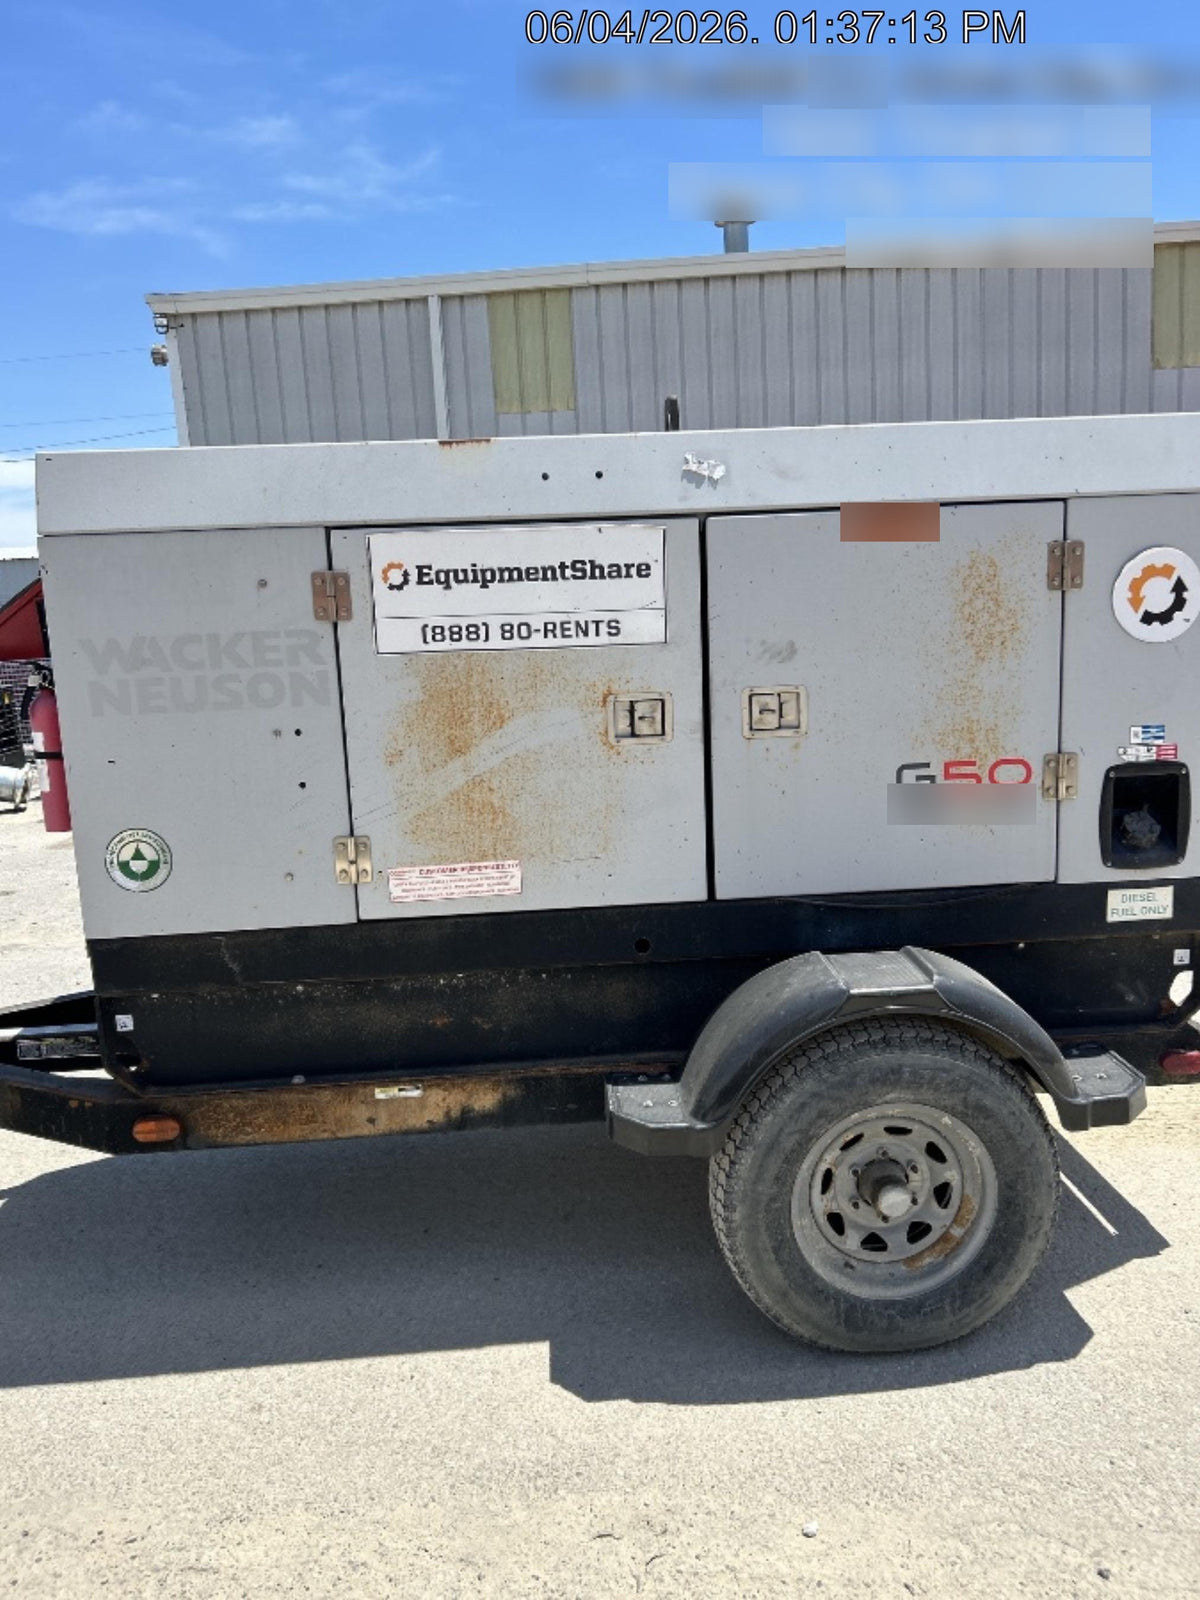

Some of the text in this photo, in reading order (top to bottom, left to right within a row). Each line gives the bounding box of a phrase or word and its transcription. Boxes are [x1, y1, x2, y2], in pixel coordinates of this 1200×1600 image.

[415, 559, 652, 589] EquipmentShare
[421, 619, 622, 644] (888) 80-RENTS
[78, 629, 327, 675] WACKER
[87, 670, 332, 718] NEUSON
[1110, 904, 1169, 918] FUEL ONLY
[1121, 892, 1158, 903] DIESEL
